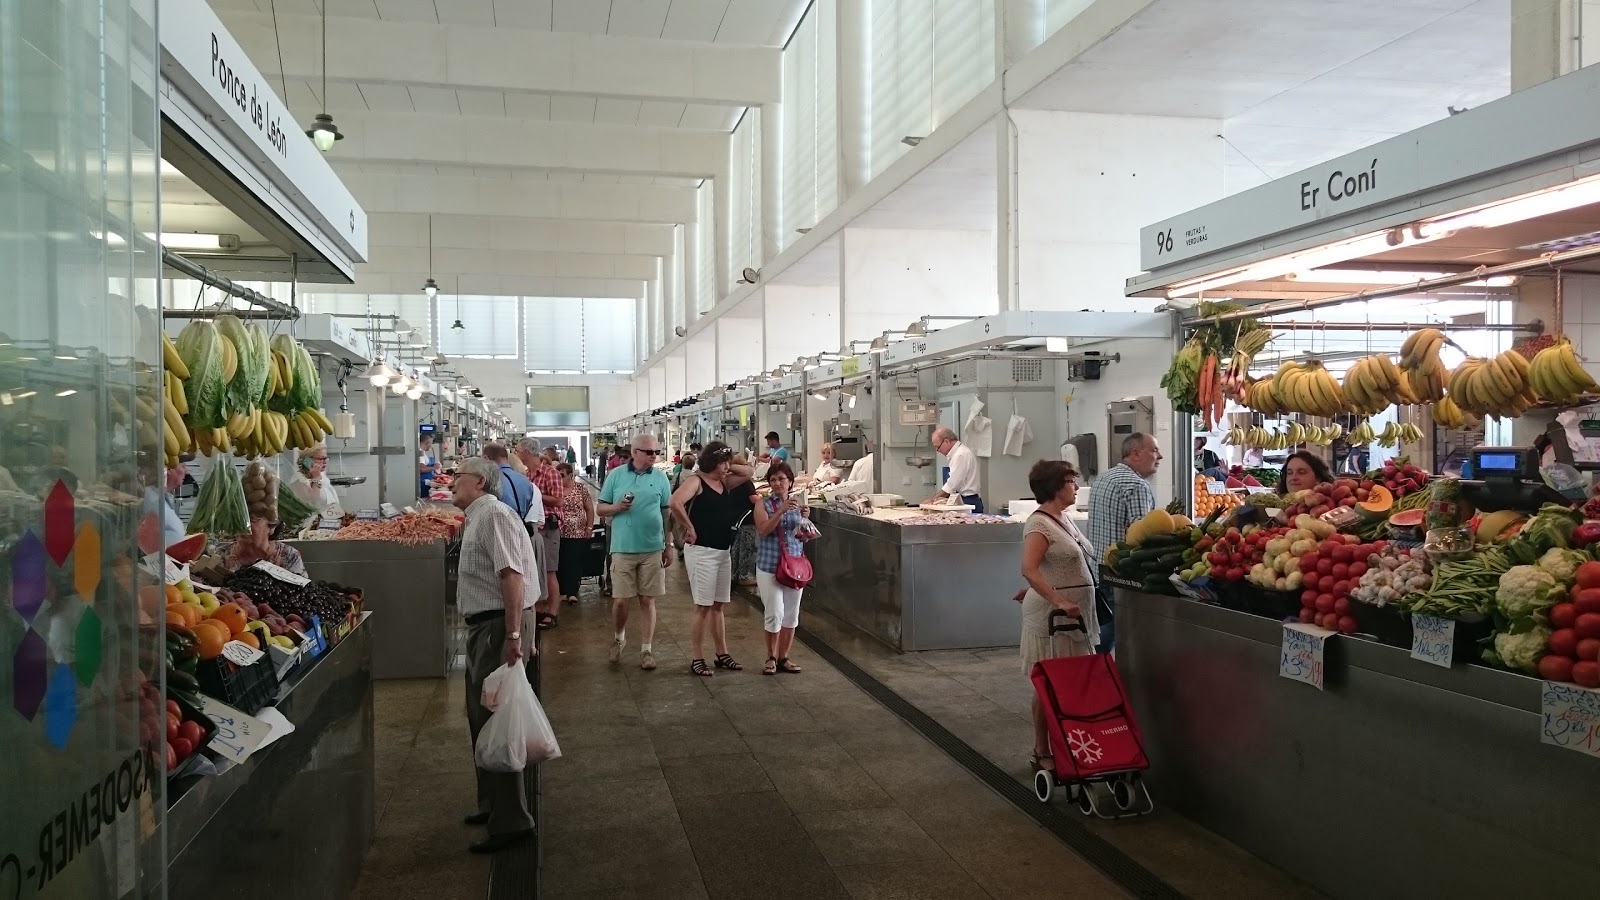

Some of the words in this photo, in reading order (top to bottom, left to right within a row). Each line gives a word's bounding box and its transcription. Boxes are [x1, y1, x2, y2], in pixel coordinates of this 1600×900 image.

[211, 31, 247, 113] Ponce
[250, 83, 263, 131] de
[266, 101, 287, 159] León
[1301, 181, 1320, 211] Er
[1327, 158, 1378, 201] Coní
[1157, 227, 1173, 255] 96
[1185, 226, 1201, 238] FRUTAS
[1201, 225, 1206, 233] Y
[1185, 233, 1208, 247] VERDURAS
[1101, 725, 1128, 735] THERMO
